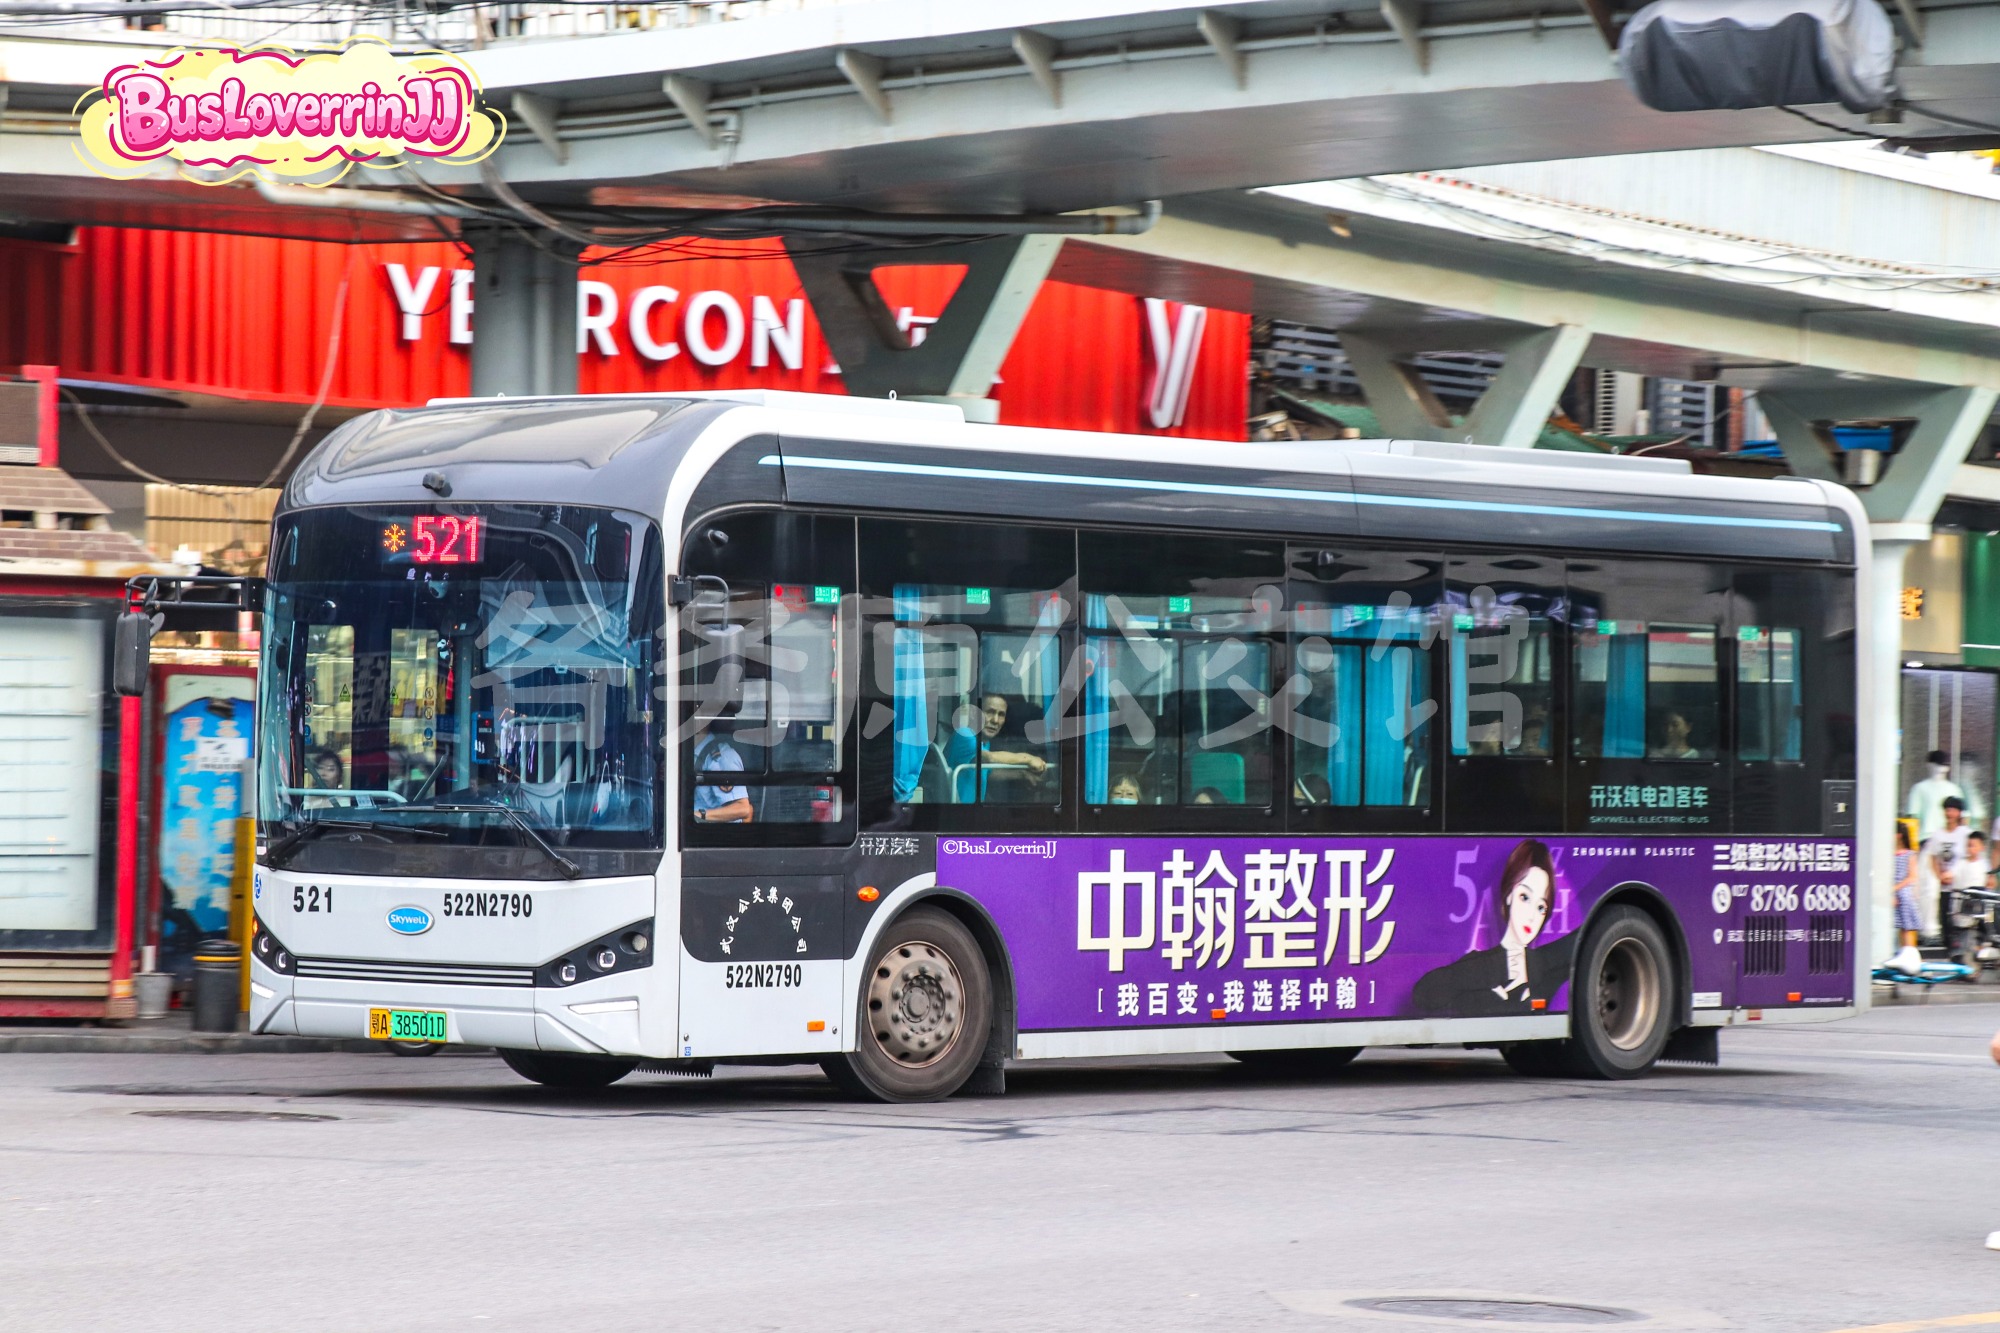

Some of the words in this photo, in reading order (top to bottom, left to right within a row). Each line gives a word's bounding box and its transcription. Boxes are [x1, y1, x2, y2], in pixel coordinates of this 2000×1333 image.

[384, 263, 804, 370] YERCON
[416, 516, 478, 562] 521
[1590, 785, 1709, 808] 开沃纯电动客车
[1589, 815, 1635, 824] SKYWELL
[1638, 815, 1686, 824] ELECTRIC
[1687, 815, 1710, 824] BUS
[1572, 847, 1638, 857] ZHONGHAN
[1644, 847, 1696, 857] PLASTIC
[293, 885, 332, 912] 521
[443, 893, 533, 917] 522N2790
[1077, 848, 1396, 972] 中翰整形
[1750, 884, 1800, 912] 8786
[1803, 884, 1852, 912] 6888
[725, 963, 802, 988] 522N2790
